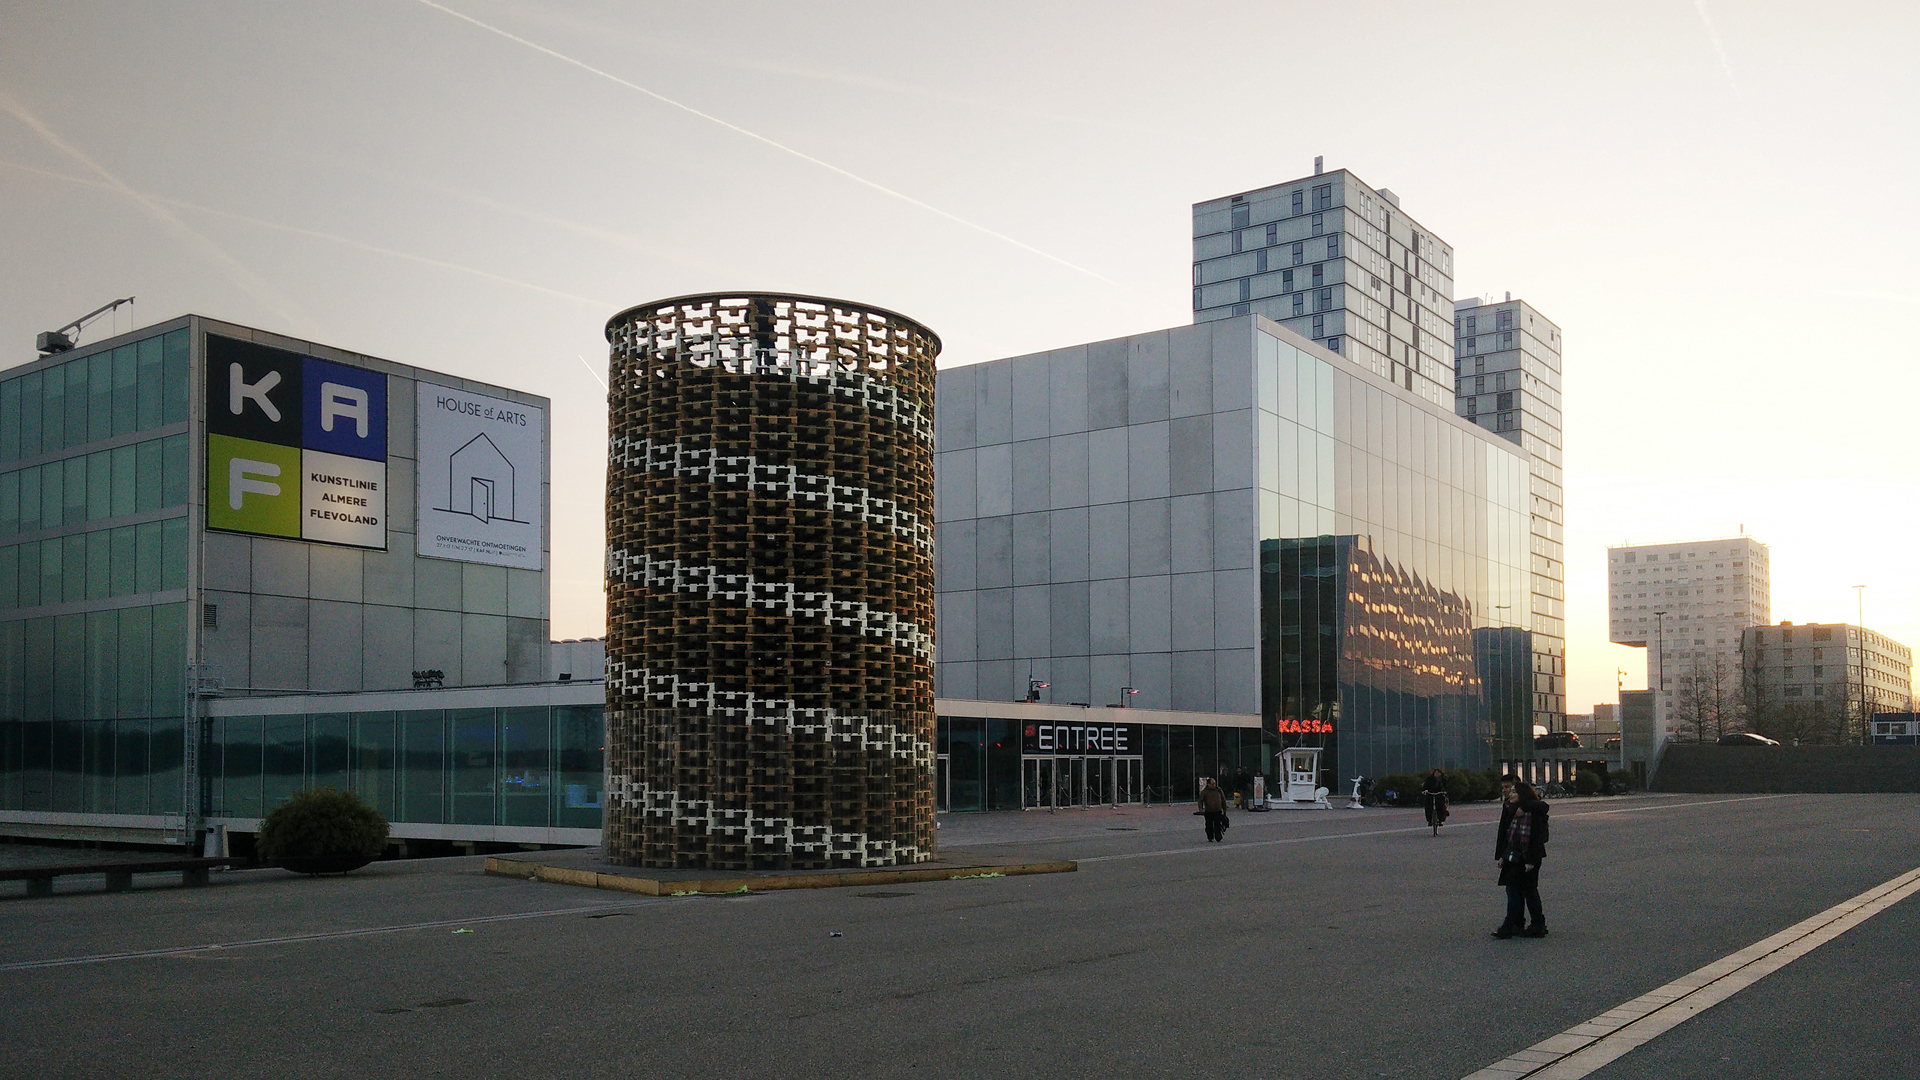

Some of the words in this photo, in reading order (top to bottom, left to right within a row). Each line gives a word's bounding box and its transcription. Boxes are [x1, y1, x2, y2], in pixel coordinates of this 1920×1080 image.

[230, 362, 281, 422] K
[321, 381, 368, 438] A
[437, 395, 481, 417] HOUSE
[484, 407, 494, 417] of
[496, 409, 527, 427] ARTS
[230, 457, 281, 510] F
[311, 472, 378, 491] KUNSTLINIE
[321, 492, 367, 507] ALMERE
[310, 508, 378, 526] FLEVOLAND
[436, 534, 480, 546] ONVERWACHTE
[481, 541, 526, 552] ONTMOETINGEN
[1279, 719, 1333, 733] KASSA
[1039, 725, 1128, 750] ENTREE
